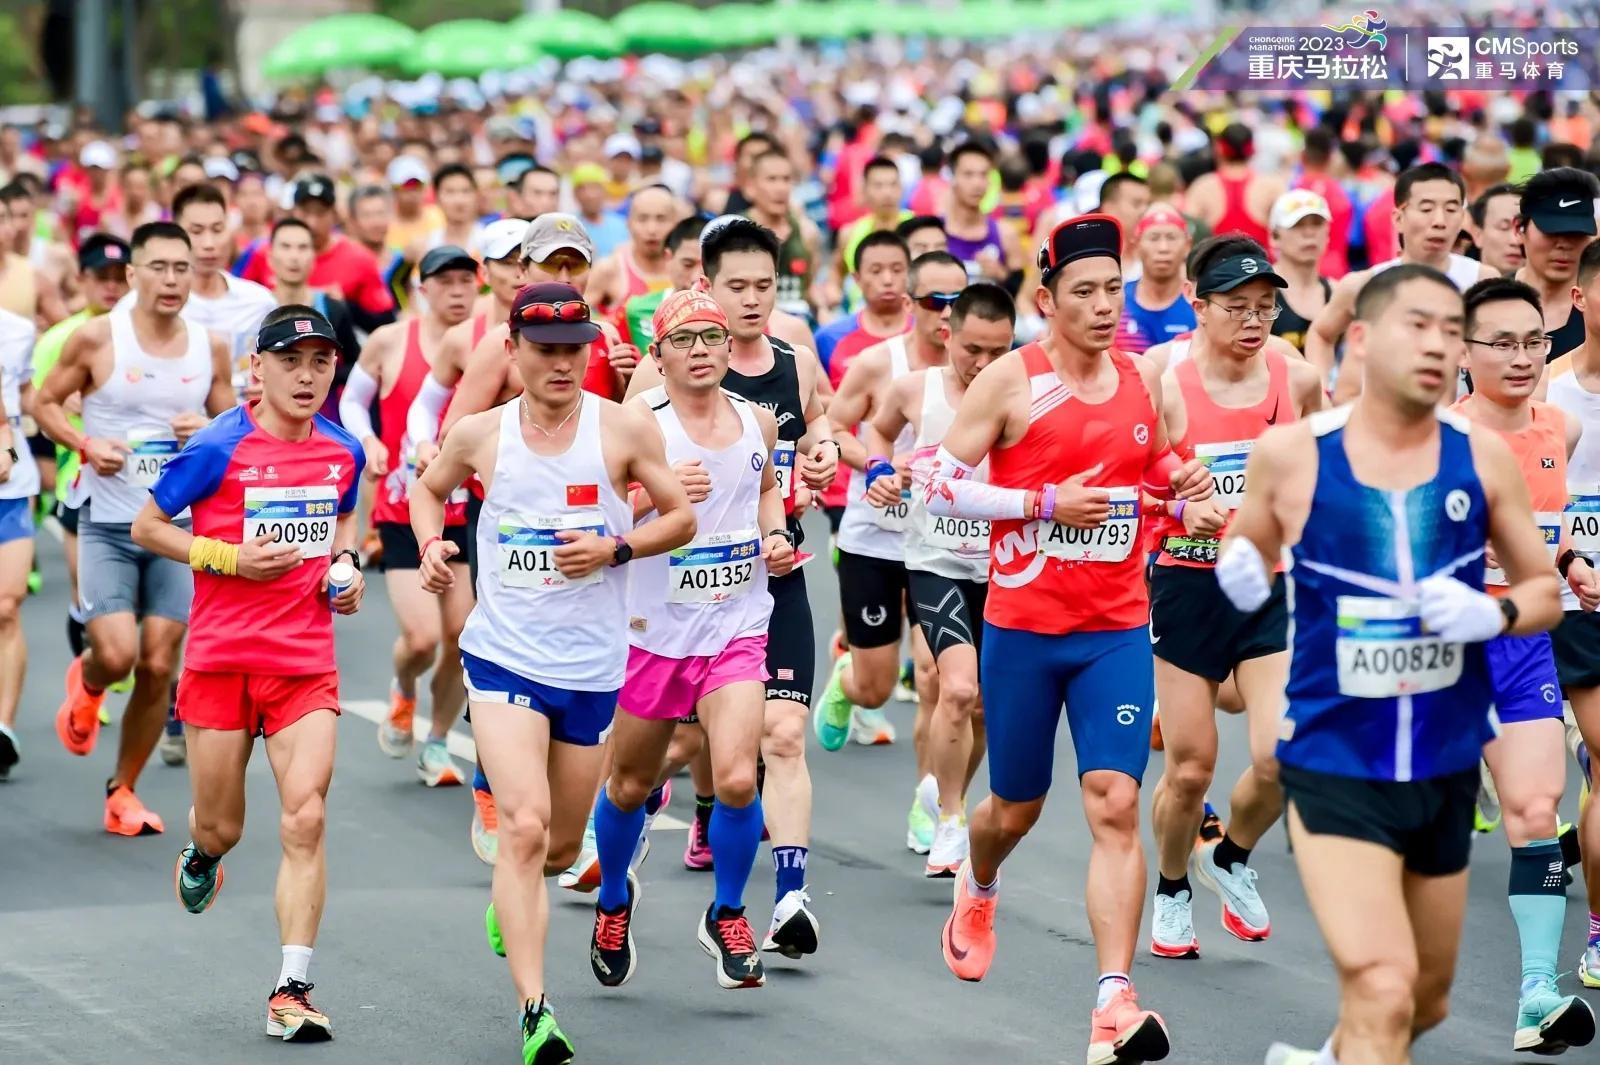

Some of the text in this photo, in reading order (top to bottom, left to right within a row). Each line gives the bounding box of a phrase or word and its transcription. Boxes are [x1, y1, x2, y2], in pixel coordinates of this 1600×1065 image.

[884, 502, 908, 518] A0
[255, 521, 329, 543] A00989
[934, 517, 991, 537] A0053
[1048, 523, 1130, 545] A00793
[1571, 516, 1599, 537] A0
[508, 550, 560, 571] A01
[679, 562, 752, 589] A01352
[1352, 642, 1456, 675] A00826
[773, 848, 808, 872] TM
